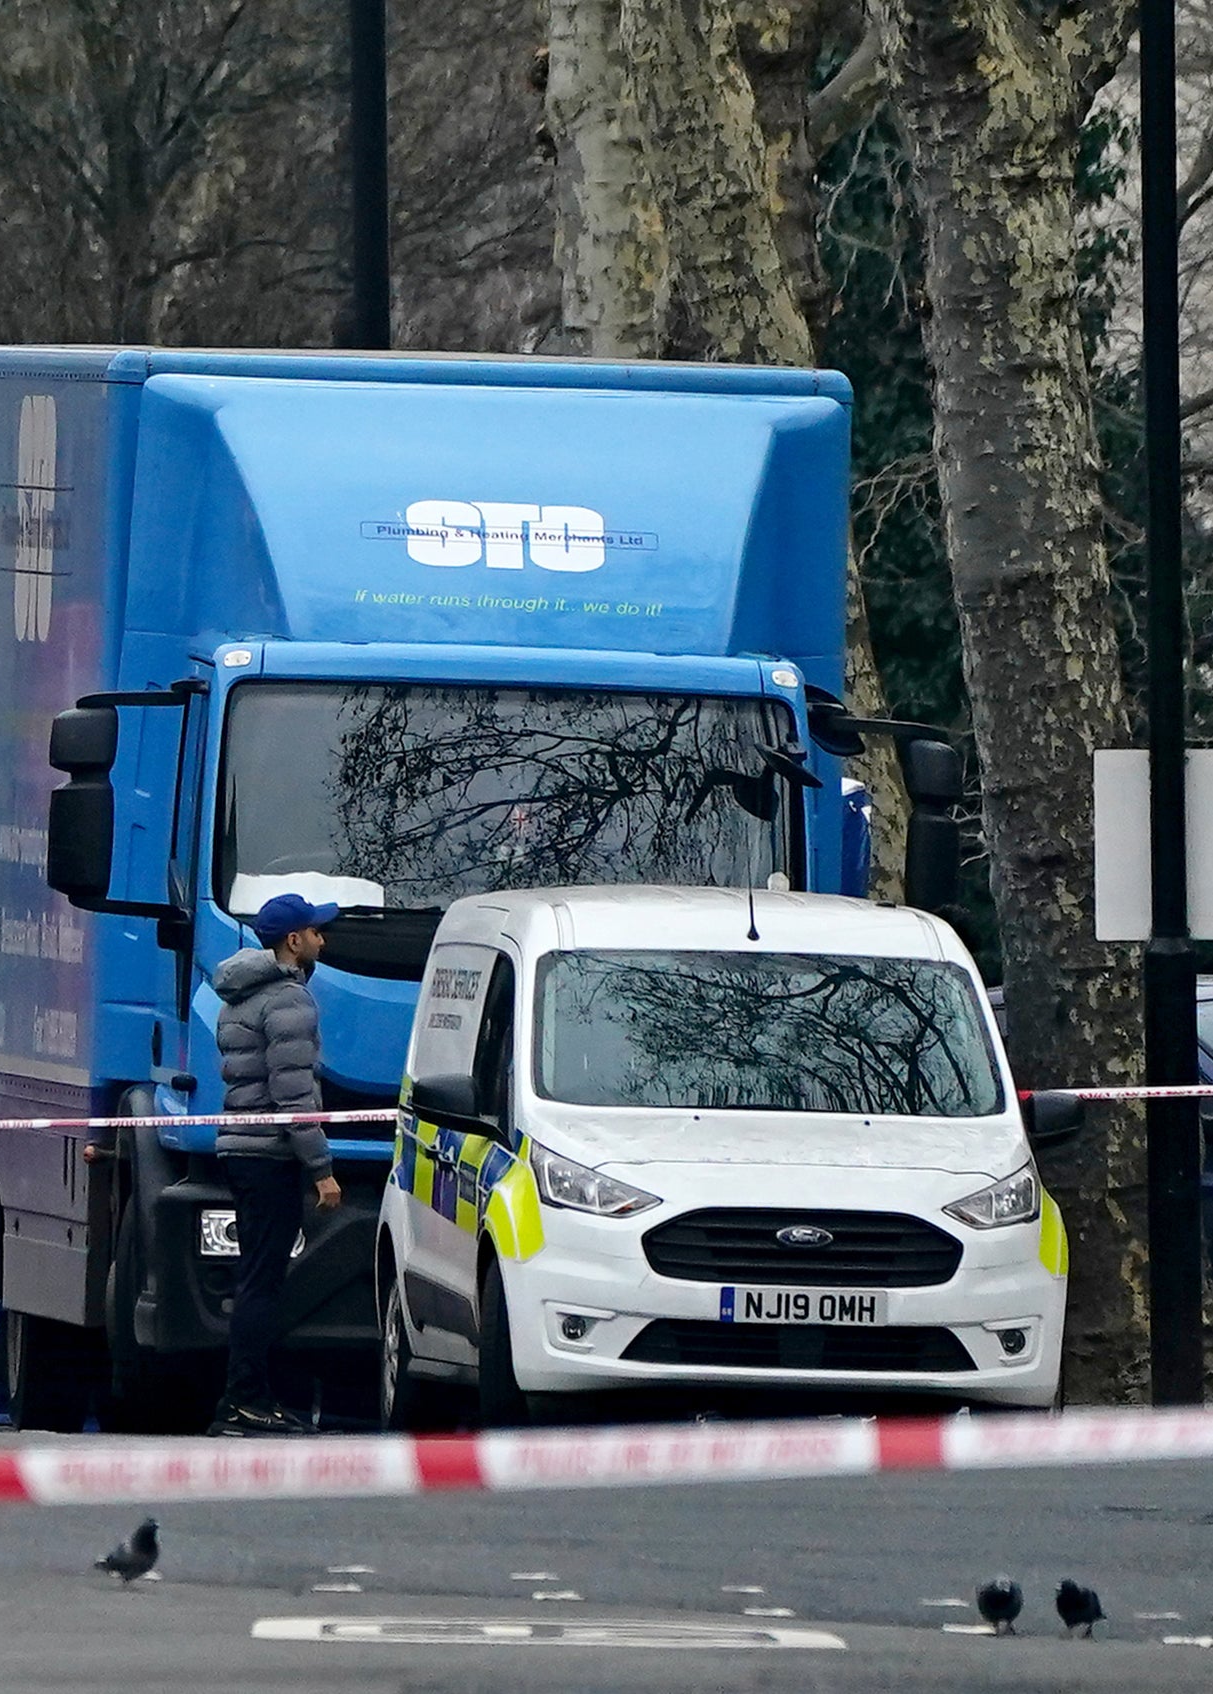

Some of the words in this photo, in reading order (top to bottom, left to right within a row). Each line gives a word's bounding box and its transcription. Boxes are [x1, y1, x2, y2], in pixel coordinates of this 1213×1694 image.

[376, 525, 449, 539] Plumbing
[454, 529, 464, 538] &
[470, 529, 529, 543] Heating
[534, 532, 614, 545] Merchants
[619, 535, 644, 546] Ltd
[354, 589, 368, 603] If
[372, 592, 424, 605] water
[429, 594, 471, 607] runs
[476, 595, 549, 613] through
[583, 602, 610, 614] we
[616, 602, 640, 615] do
[645, 603, 663, 617] it!
[789, 1228, 821, 1243] Ford
[745, 1291, 810, 1321] NJ19
[819, 1294, 876, 1323] OMH
